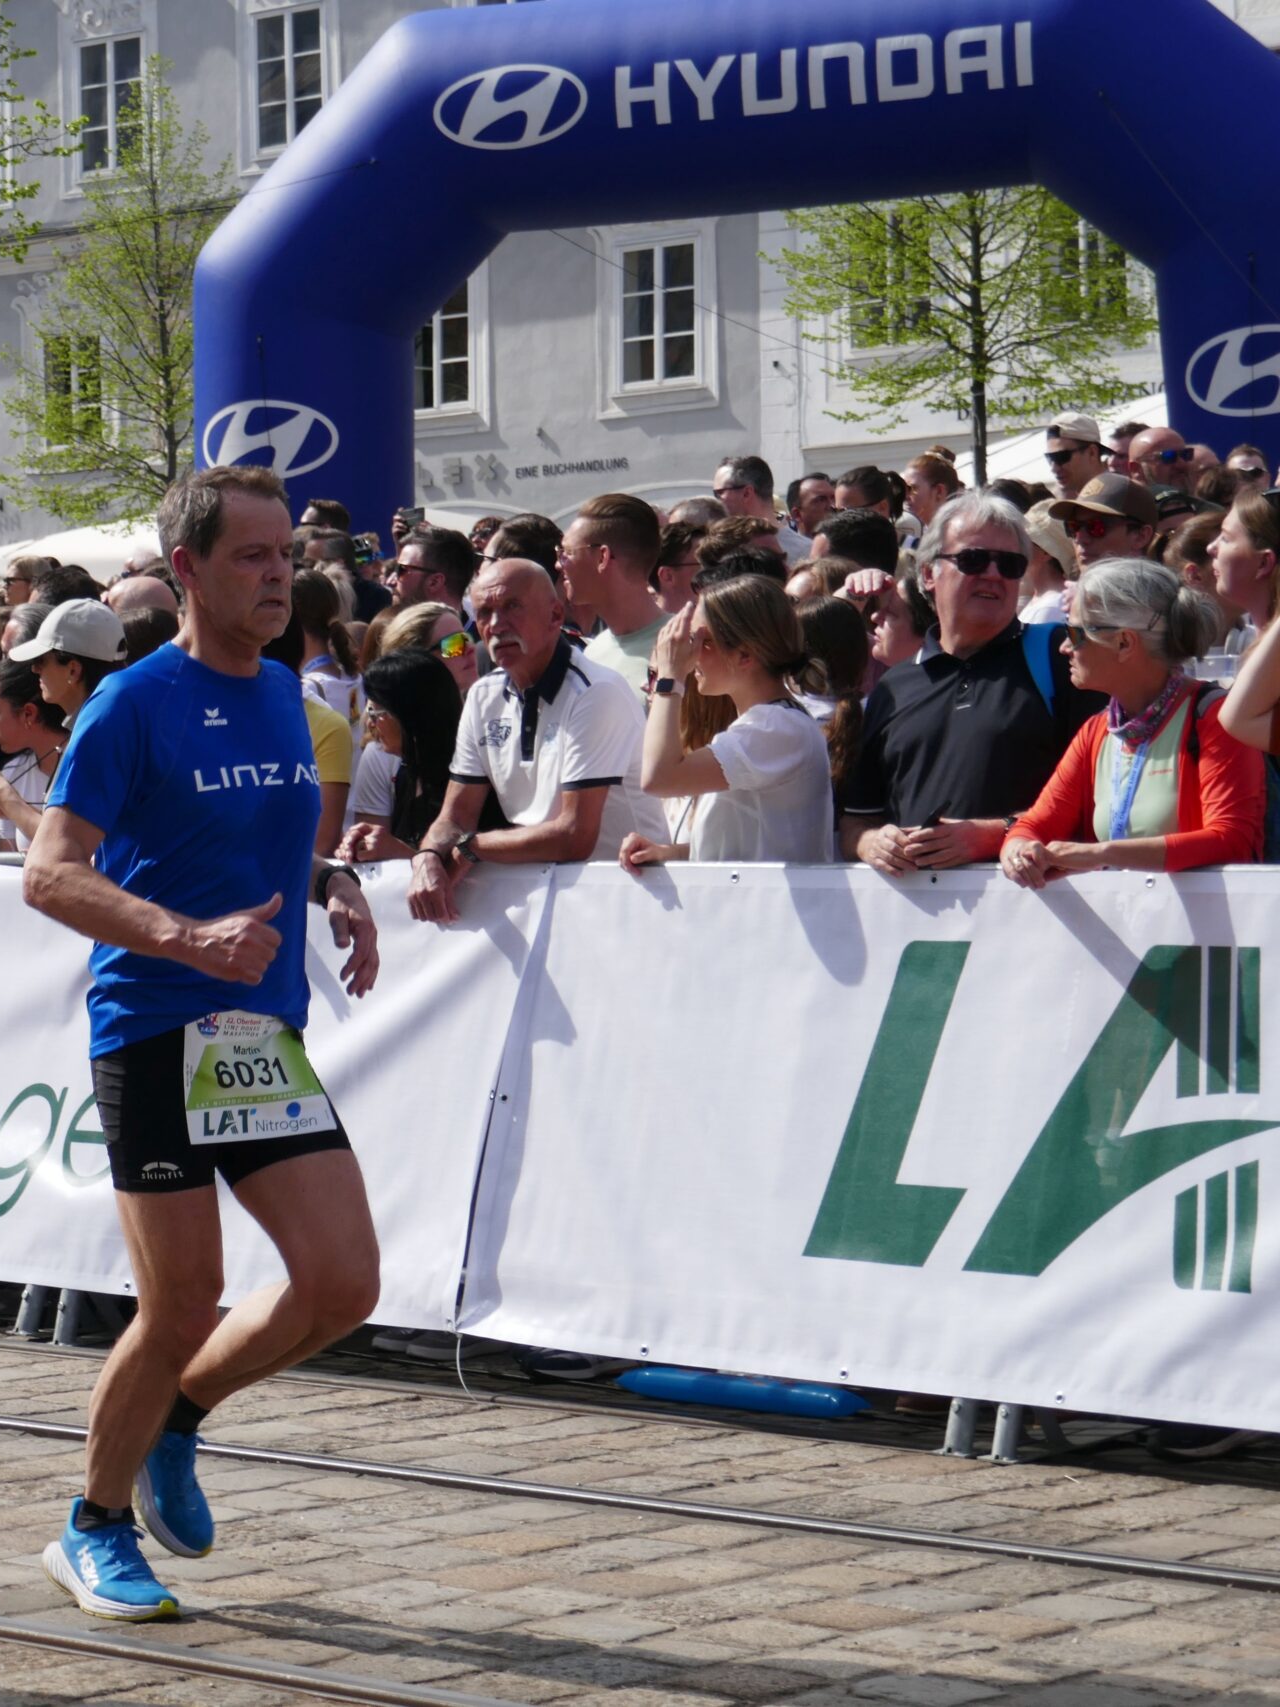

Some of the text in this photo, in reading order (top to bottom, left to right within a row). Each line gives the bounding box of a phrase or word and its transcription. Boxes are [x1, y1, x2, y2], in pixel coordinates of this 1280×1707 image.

[615, 21, 1034, 129] HYUNDAI
[516, 457, 630, 479] EINE BUCHHANDLUNG
[194, 763, 284, 792] LINZ
[233, 1045, 261, 1056] Martin
[214, 1057, 289, 1089] 6031
[203, 1109, 318, 1137] LAT Nitrogen
[141, 1171, 184, 1180] skinfit
